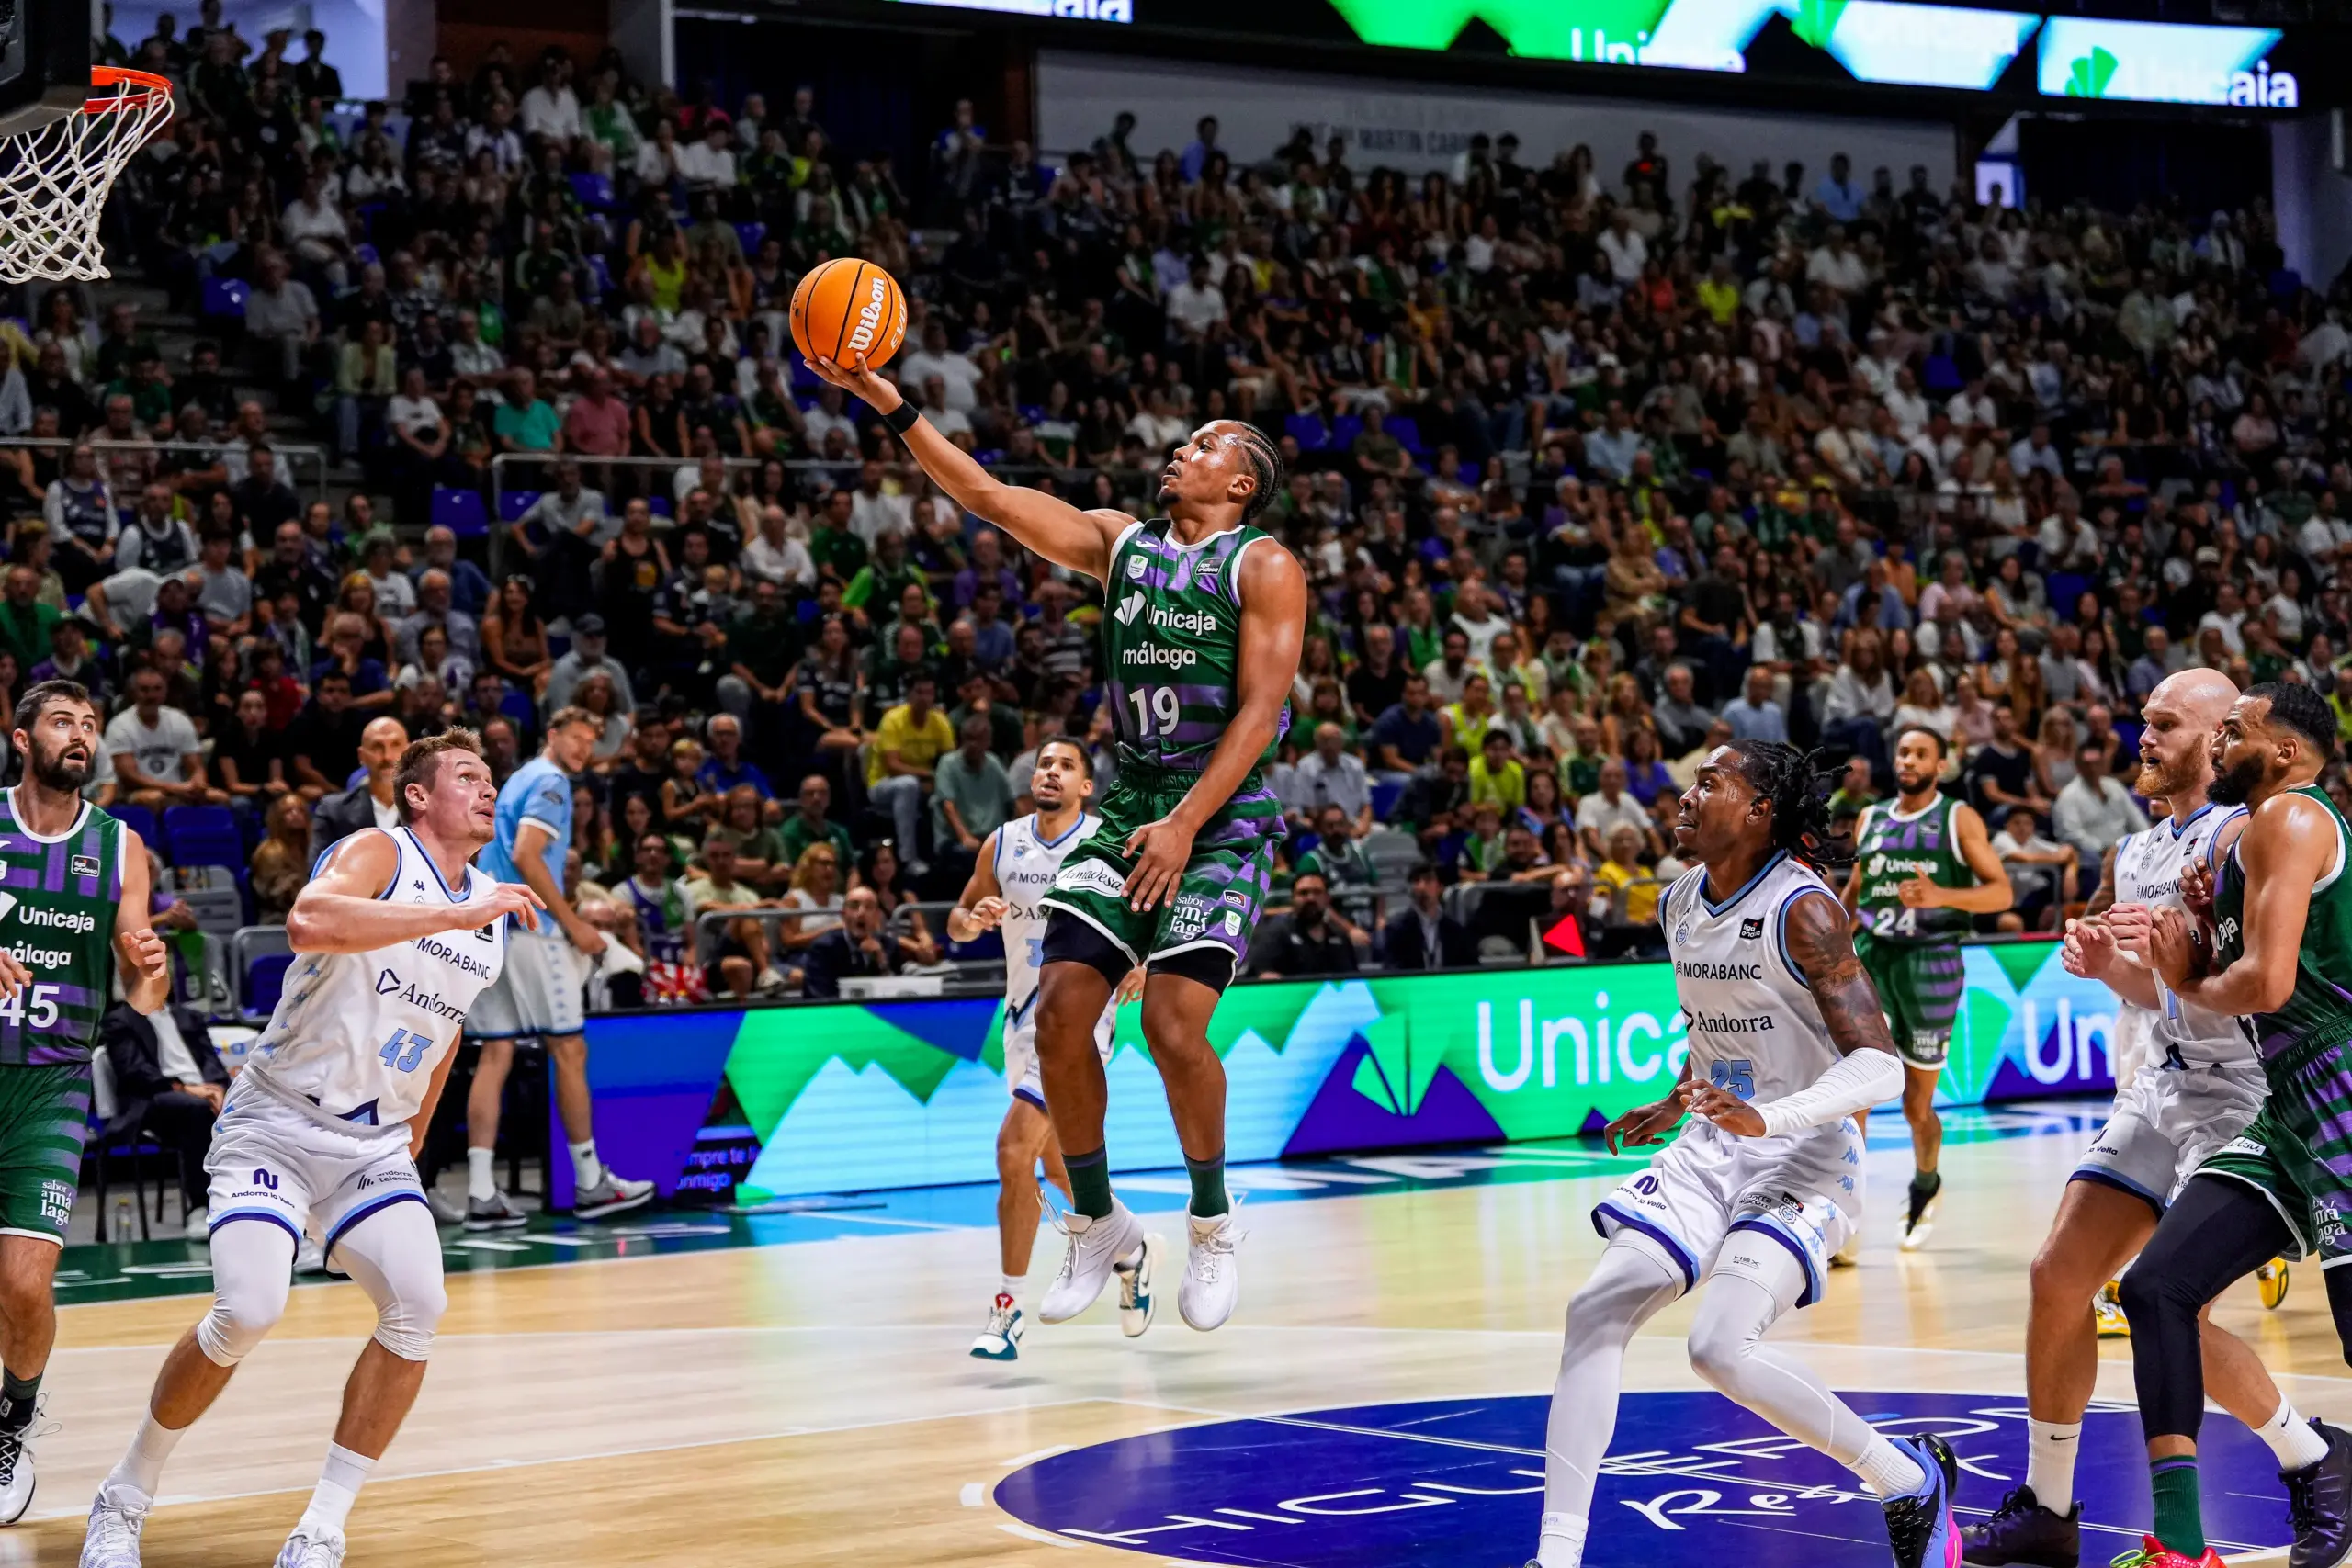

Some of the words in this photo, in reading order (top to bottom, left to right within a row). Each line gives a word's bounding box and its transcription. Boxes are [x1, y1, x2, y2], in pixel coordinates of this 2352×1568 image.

[848, 277, 885, 351] Wilson
[1146, 604, 1216, 637] Unicaja
[1123, 640, 1196, 671] málaga
[1129, 686, 1180, 736] 19
[1177, 895, 1205, 908] sabor
[18, 906, 95, 934] Unicaja
[1741, 930, 1761, 938] enda
[1872, 907, 1917, 937] 24
[416, 937, 491, 981] MORABANC
[1683, 963, 1763, 981] MORABANC
[1698, 1010, 1775, 1033] Andorra
[379, 1028, 434, 1074] 43
[1710, 1059, 1756, 1101] 25
[2096, 1145, 2119, 1156] Vella
[42, 1179, 67, 1193] sabor
[231, 1190, 268, 1199] Andorra
